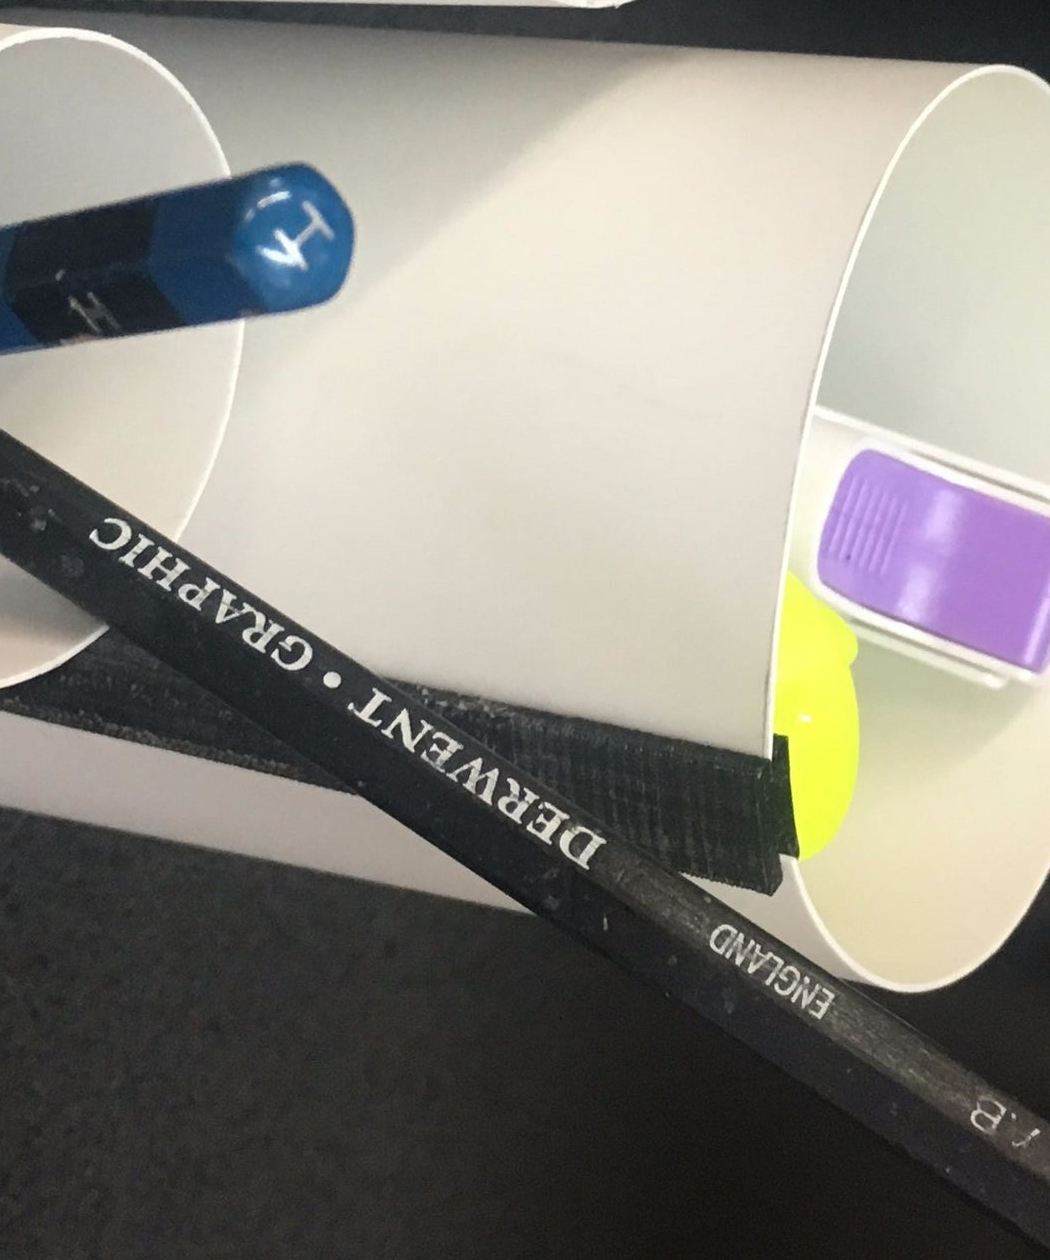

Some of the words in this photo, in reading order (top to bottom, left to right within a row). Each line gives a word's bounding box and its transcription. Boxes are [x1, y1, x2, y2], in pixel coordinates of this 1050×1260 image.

[88, 516, 314, 672] GRAPHIC
[347, 687, 608, 871] DERWENT
[708, 923, 836, 1020] ENGLAND
